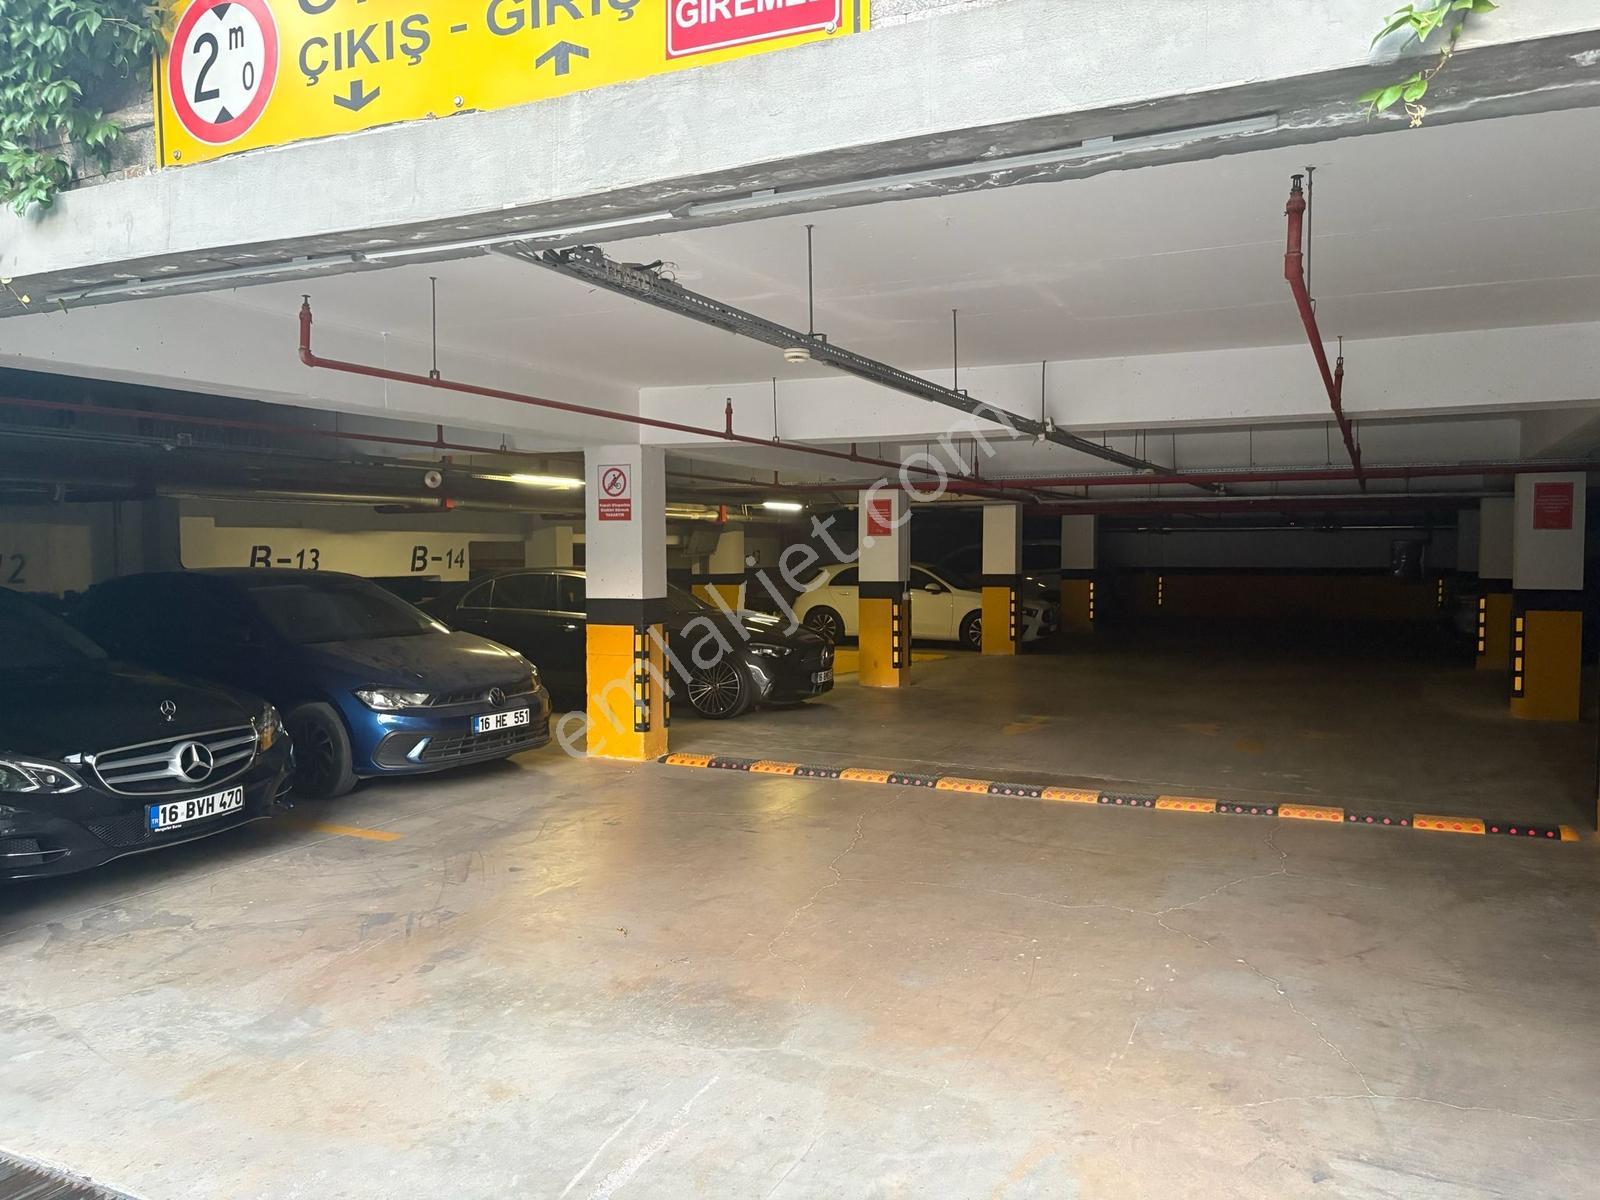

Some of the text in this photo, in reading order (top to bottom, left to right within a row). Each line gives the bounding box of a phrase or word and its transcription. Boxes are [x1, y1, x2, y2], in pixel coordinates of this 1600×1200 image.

[193, 33, 220, 103] 2
[229, 26, 245, 50] m
[299, 13, 431, 87] ÇIKIŞ
[250, 545, 320, 570] B-13
[410, 545, 465, 572] B-14
[480, 717, 490, 731] 16
[495, 714, 508, 728] HE
[514, 710, 529, 724] 551
[161, 788, 242, 824] 16 BVH 470
